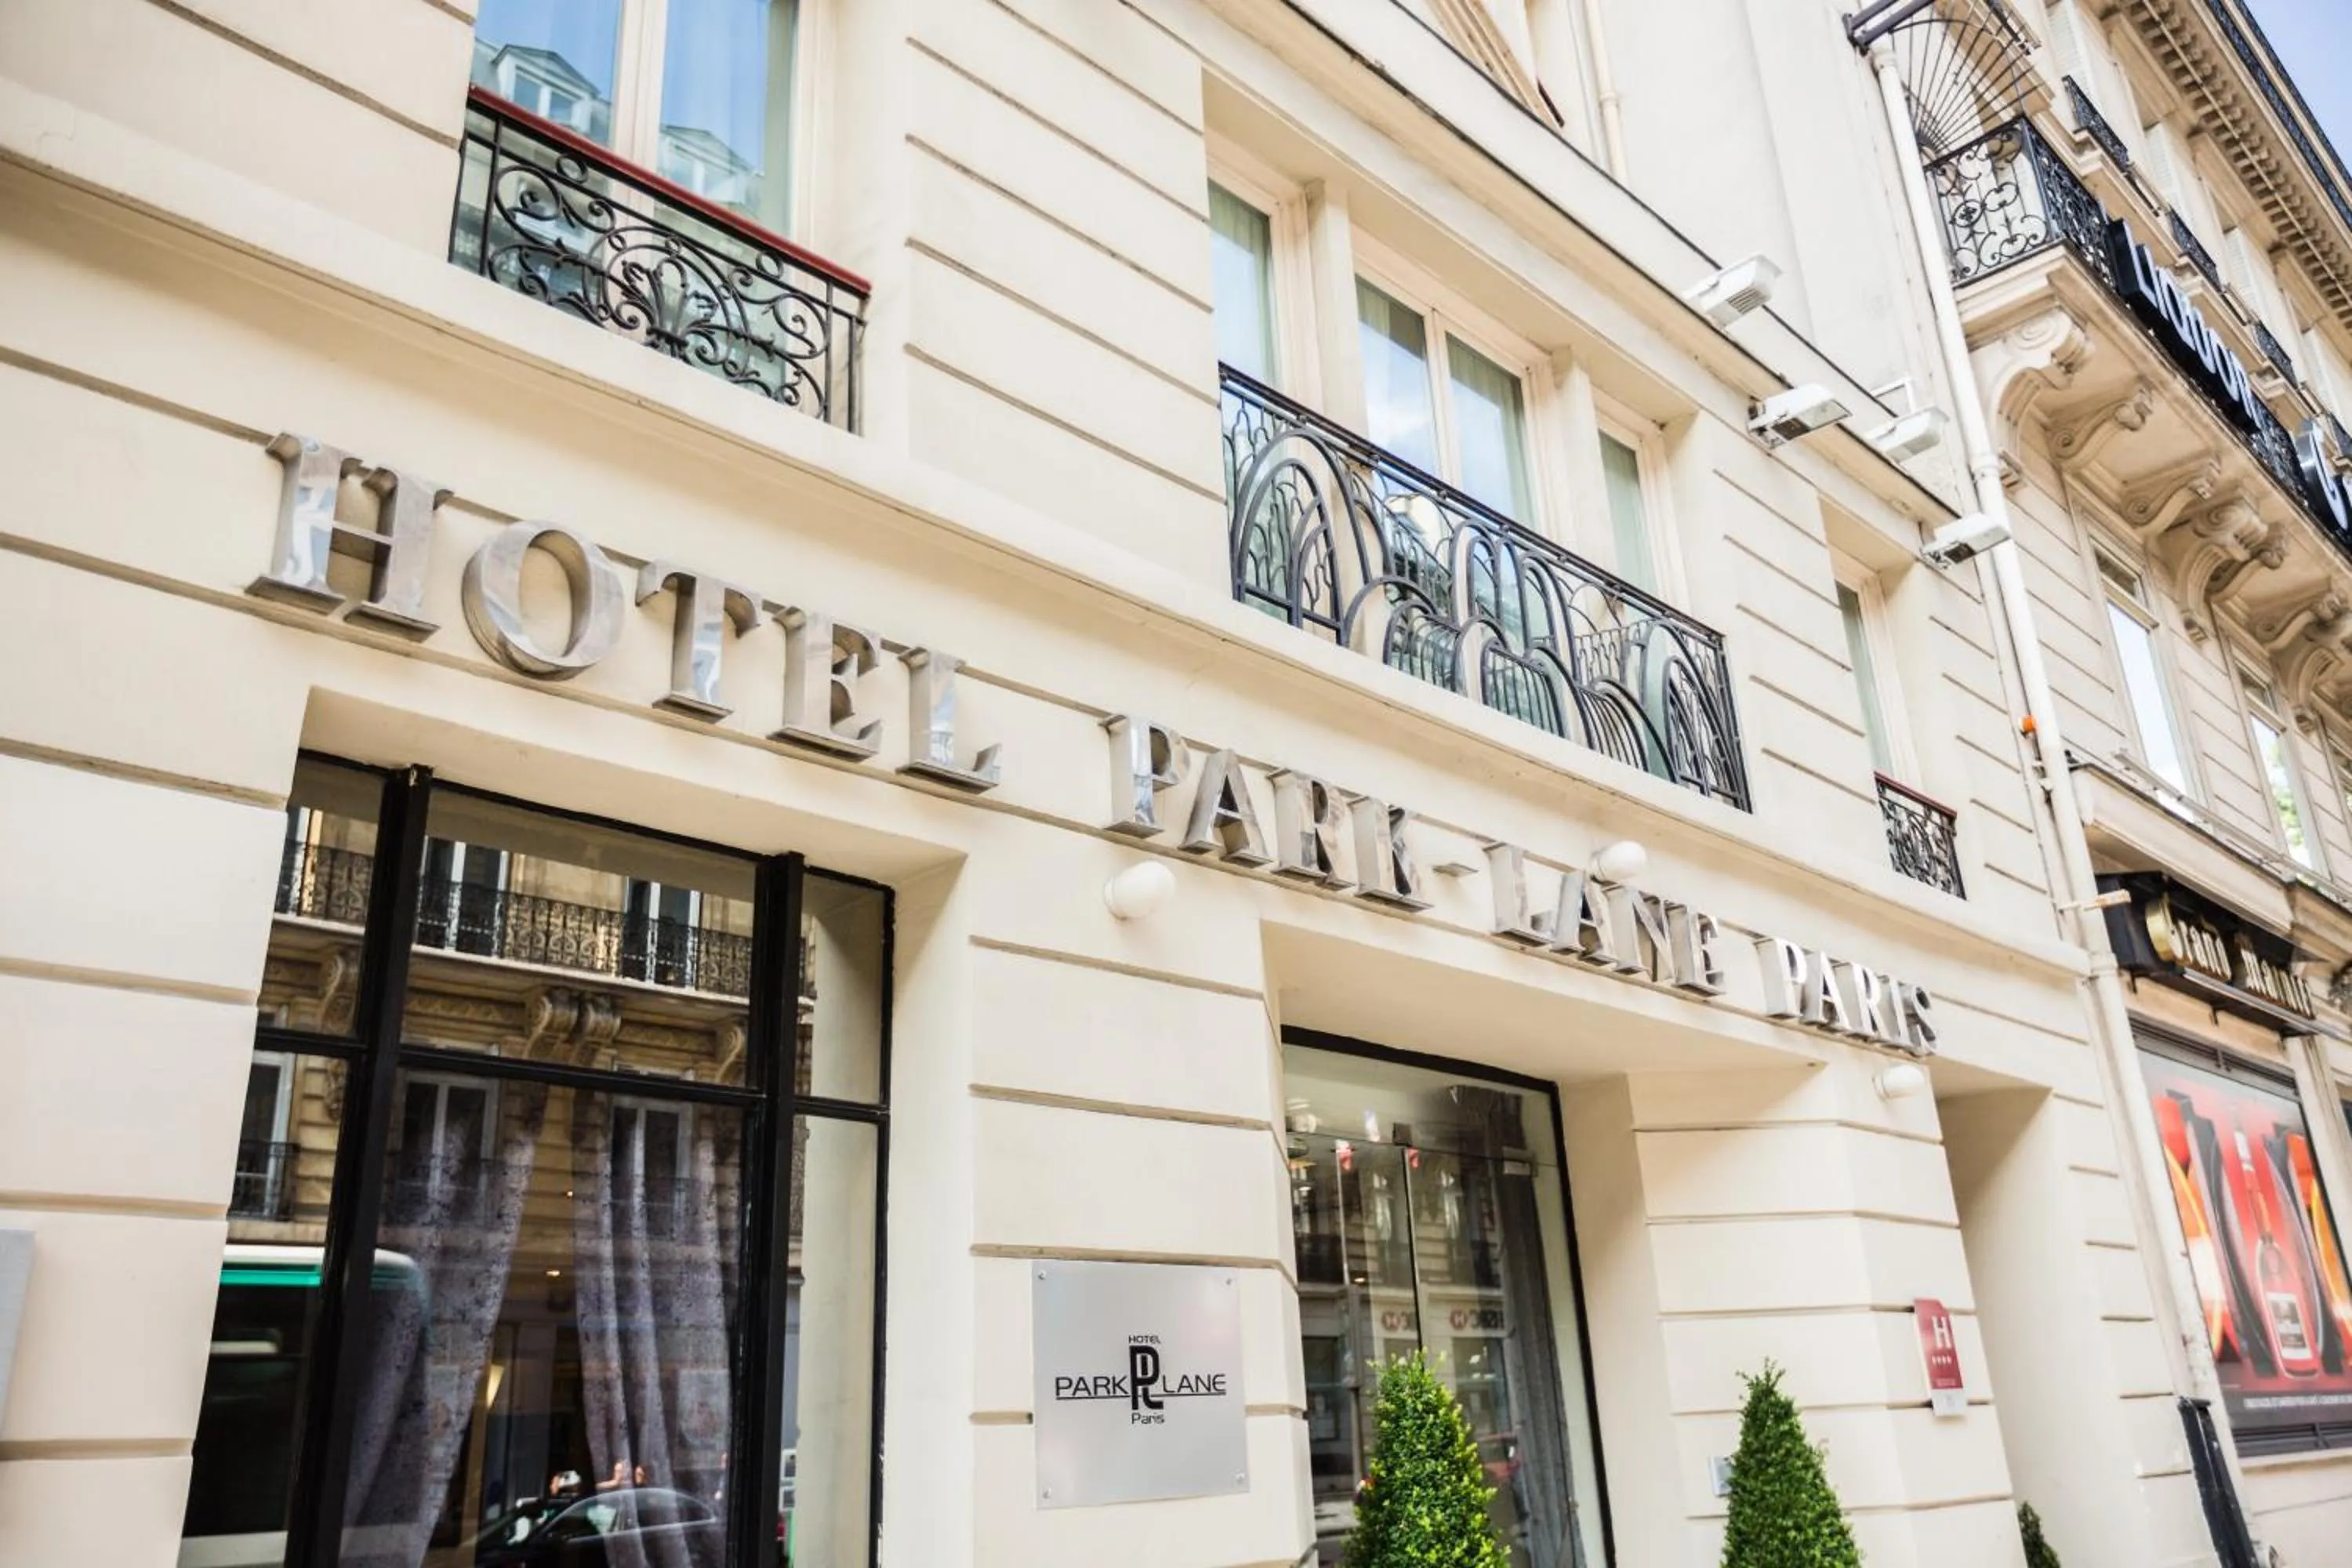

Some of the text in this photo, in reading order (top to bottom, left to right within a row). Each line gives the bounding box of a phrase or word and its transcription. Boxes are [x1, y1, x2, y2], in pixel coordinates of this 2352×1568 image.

[244, 430, 1003, 796] HOTEL
[1752, 937, 1938, 1058] PARIS
[1127, 1334, 1162, 1345] HOTEL
[1932, 1316, 1953, 1350] H
[1054, 1374, 1227, 1396] PARK LANE
[1131, 1412, 1166, 1425] Paris
